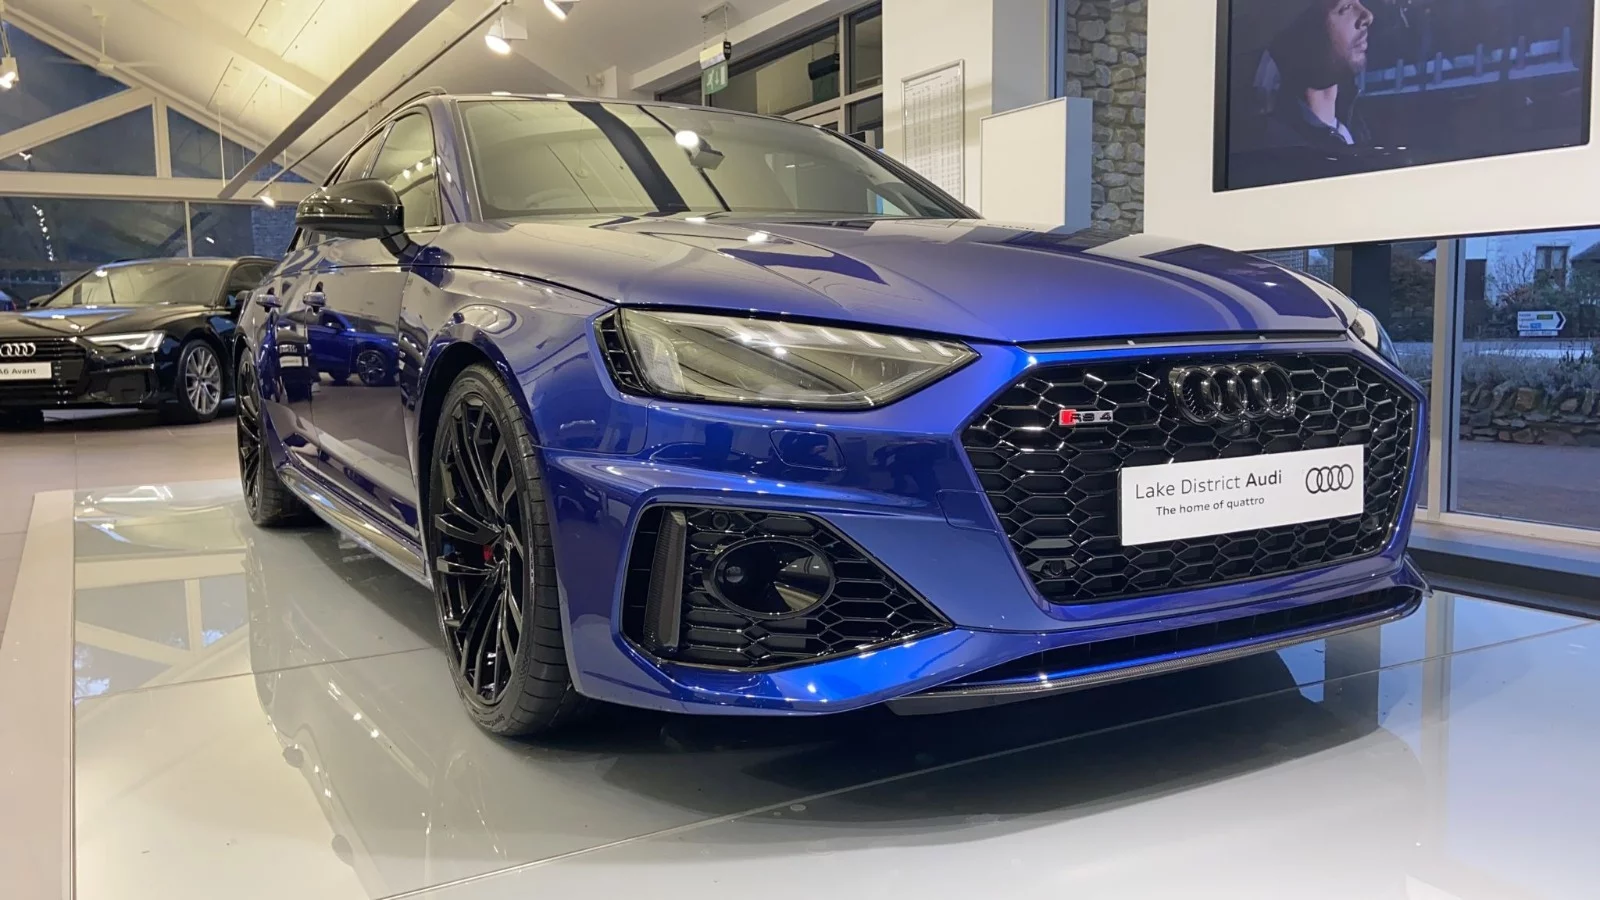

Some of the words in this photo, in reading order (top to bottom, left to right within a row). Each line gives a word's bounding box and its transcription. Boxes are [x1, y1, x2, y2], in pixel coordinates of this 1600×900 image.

[1069, 412, 1095, 423] RS
[1099, 412, 1112, 421] 4
[1135, 481, 1175, 499] Lake
[1181, 475, 1241, 495] District
[1245, 469, 1282, 487] Audi
[1156, 506, 1176, 516] The
[1179, 502, 1210, 513] home
[1213, 500, 1224, 510] of
[1227, 496, 1265, 509] quattro
